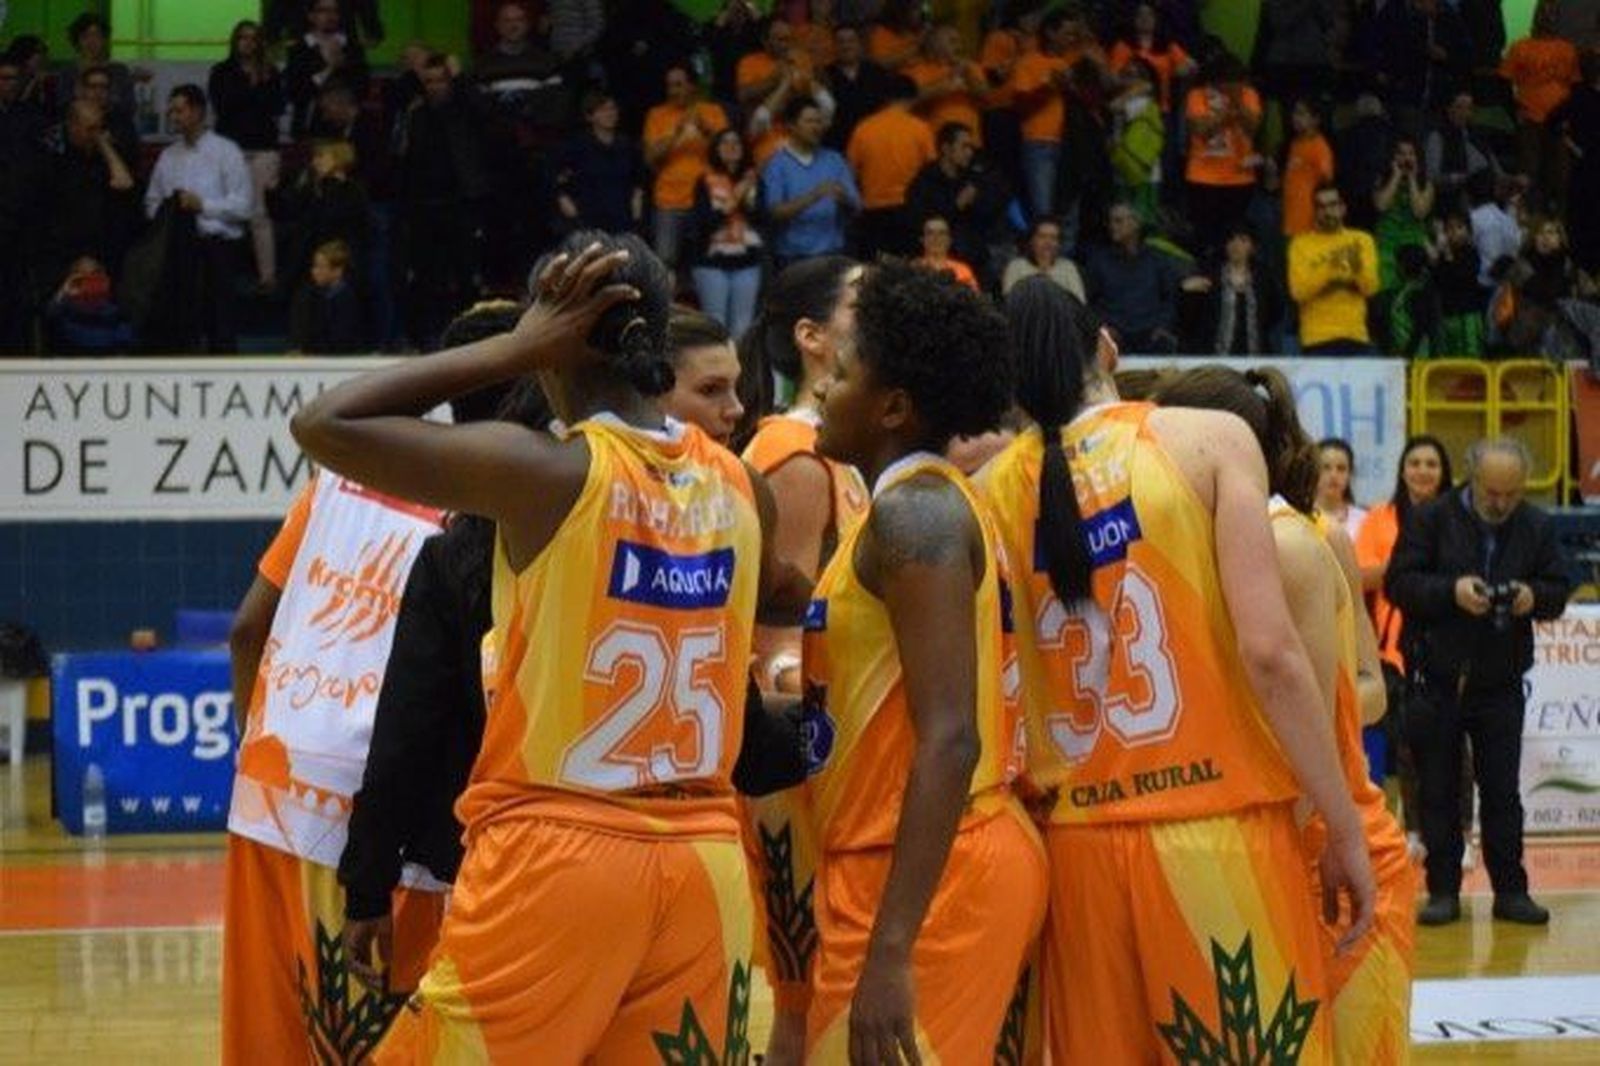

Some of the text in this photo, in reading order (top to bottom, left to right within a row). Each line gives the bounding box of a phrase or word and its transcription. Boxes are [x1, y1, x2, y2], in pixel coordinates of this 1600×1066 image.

[23, 440, 108, 495] DE
[556, 618, 726, 791] 25
[1036, 560, 1183, 768] 33
[77, 678, 231, 759] Prog
[1132, 757, 1223, 796] RURAL
